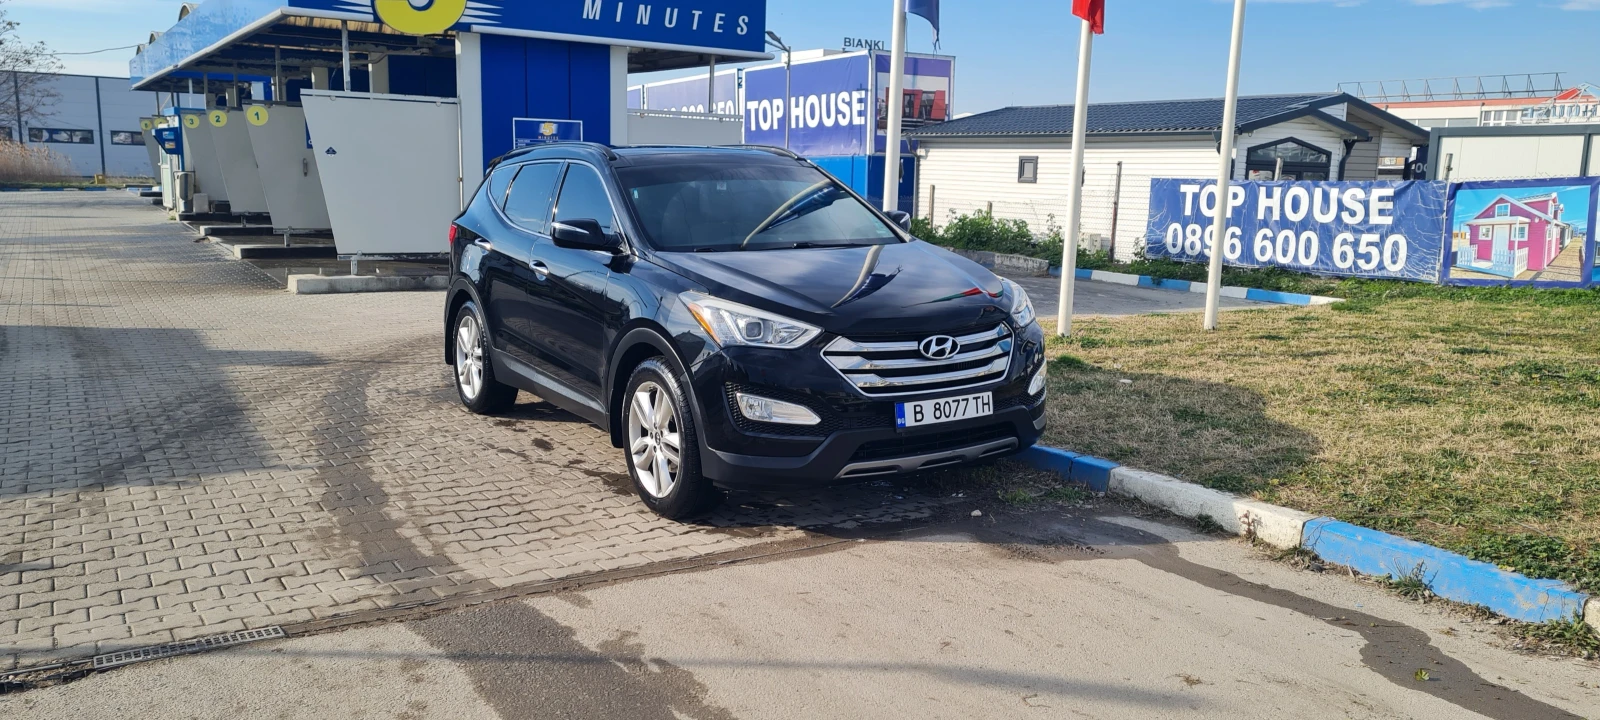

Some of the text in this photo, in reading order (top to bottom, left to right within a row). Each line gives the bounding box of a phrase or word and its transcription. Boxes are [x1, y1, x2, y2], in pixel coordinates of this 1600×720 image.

[582, 0, 749, 35] MINUTES
[843, 37, 884, 50] BIANKI
[215, 115, 221, 123] 2
[254, 111, 260, 121] 1
[746, 91, 866, 131] TOP HOUSE
[542, 122, 554, 136] 5
[1180, 184, 1395, 225] TOP HOUSE
[1253, 228, 1319, 266] 600
[1332, 232, 1408, 272] 650
[913, 394, 991, 423] B 8077 TH
